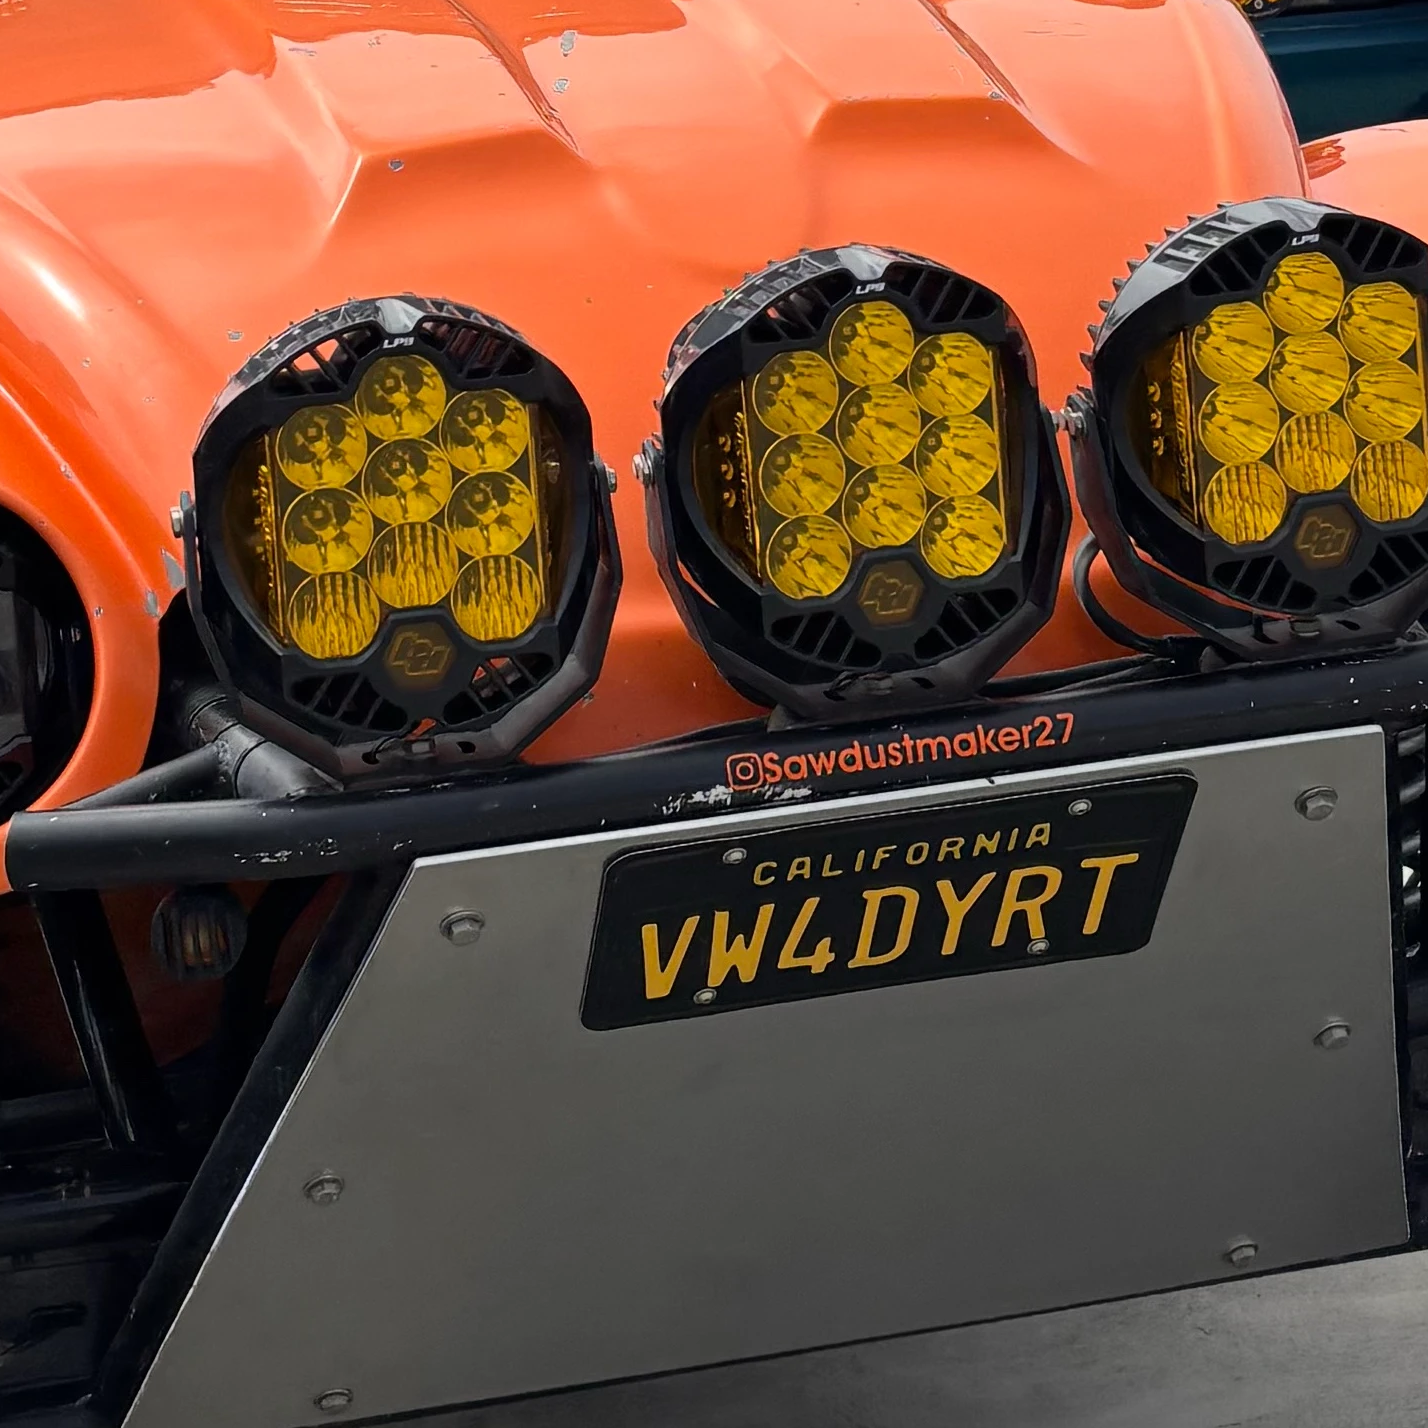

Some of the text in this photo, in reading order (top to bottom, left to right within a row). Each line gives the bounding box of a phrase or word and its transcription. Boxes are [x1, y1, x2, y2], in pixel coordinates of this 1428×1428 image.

[762, 712, 1076, 784] Sawdustmaker27
[753, 822, 1052, 887] CALIFORNIA
[641, 852, 1140, 1000] VW4DYRT
